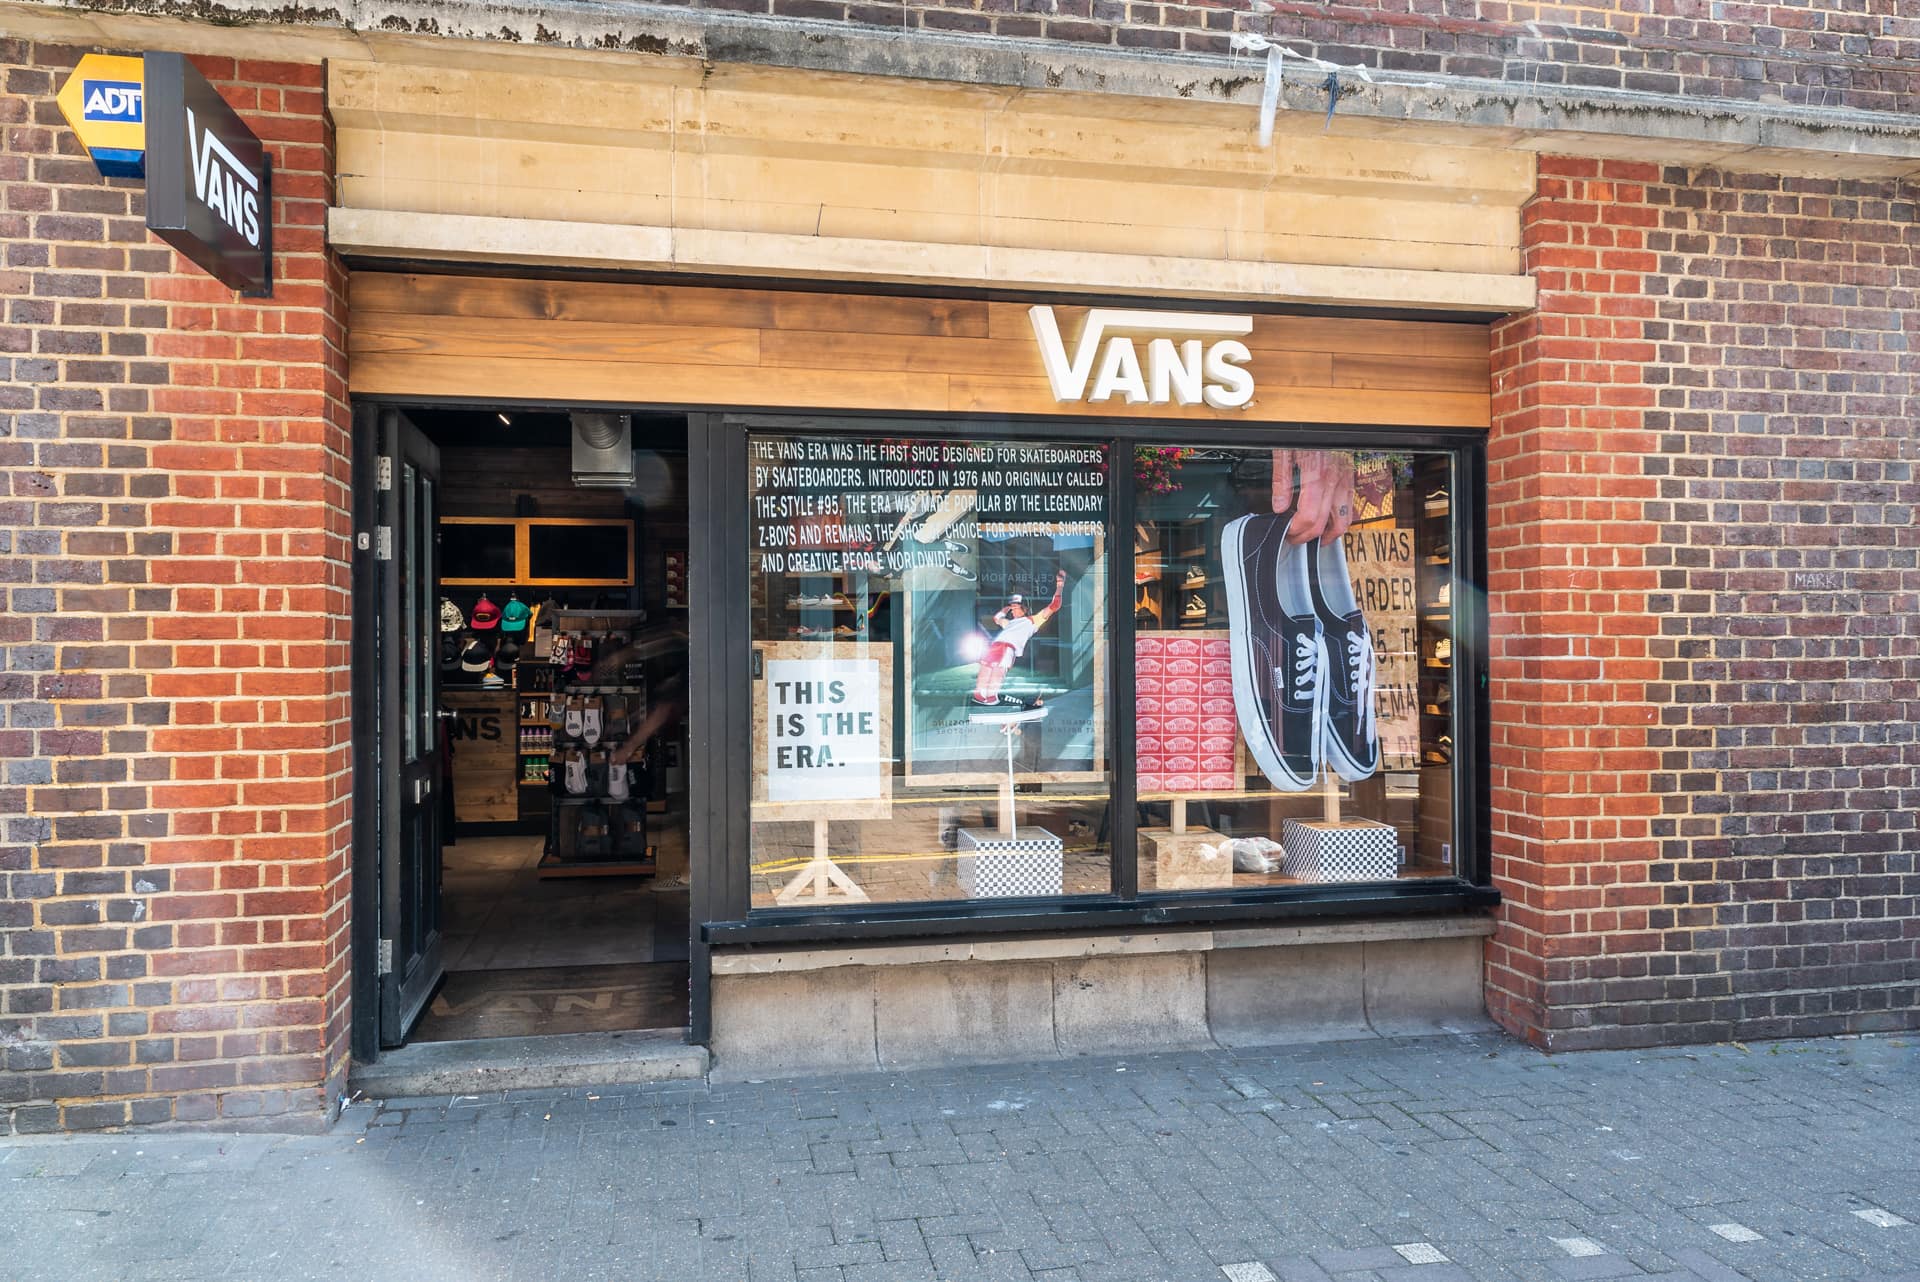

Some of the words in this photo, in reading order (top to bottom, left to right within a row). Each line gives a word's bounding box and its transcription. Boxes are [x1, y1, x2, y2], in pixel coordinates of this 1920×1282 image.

[85, 87, 142, 116] ADT
[187, 106, 261, 247] VANS
[1028, 305, 1255, 411] VANS
[753, 441, 775, 459] THE
[777, 442, 804, 460] VANS
[808, 443, 828, 460] ERA
[831, 443, 853, 461] WAS
[856, 444, 877, 461] THE
[880, 444, 908, 462] FIRST
[912, 445, 939, 462] SHOE
[943, 446, 994, 463] DESIGNED
[997, 447, 1017, 463] FOR
[1020, 448, 1102, 463] SKATEBOARDERS
[755, 466, 769, 488] BY
[772, 467, 865, 488] SKATEBOARDERS.
[868, 468, 934, 487] INTRODUCED
[938, 469, 949, 486] IN
[953, 470, 978, 486] 1976
[981, 471, 1002, 486] AND
[1005, 471, 1064, 487] ORIGINALLY
[1066, 471, 1104, 486] CALLED
[755, 495, 777, 518] THE
[780, 495, 813, 518] STYLE
[817, 495, 842, 517] #95,
[846, 494, 867, 514] THE
[871, 494, 891, 513] ERA
[895, 495, 917, 513] WAS
[924, 494, 949, 512] MADE
[953, 495, 1001, 512] POPULAR
[1004, 494, 1018, 512] BY
[1021, 495, 1041, 512] THE
[1044, 495, 1103, 512] LEGENDARY
[758, 525, 797, 547] Z-BOYS
[800, 524, 822, 545] AND
[824, 523, 873, 544] REMAINS
[874, 522, 894, 542] THE
[945, 521, 983, 540] CHOICE
[985, 521, 1006, 538] FOR
[1058, 521, 1107, 538] SURFERS,
[1344, 531, 1367, 562] RA
[1372, 531, 1410, 562] WAS
[761, 553, 784, 573] AND
[787, 552, 840, 573] CREATIVE
[842, 551, 884, 571] PEOPLE
[1795, 572, 1836, 588] MARK
[774, 680, 846, 705] THIS
[776, 713, 805, 737] IS
[816, 711, 874, 736] THE
[776, 744, 846, 769] ERA.
